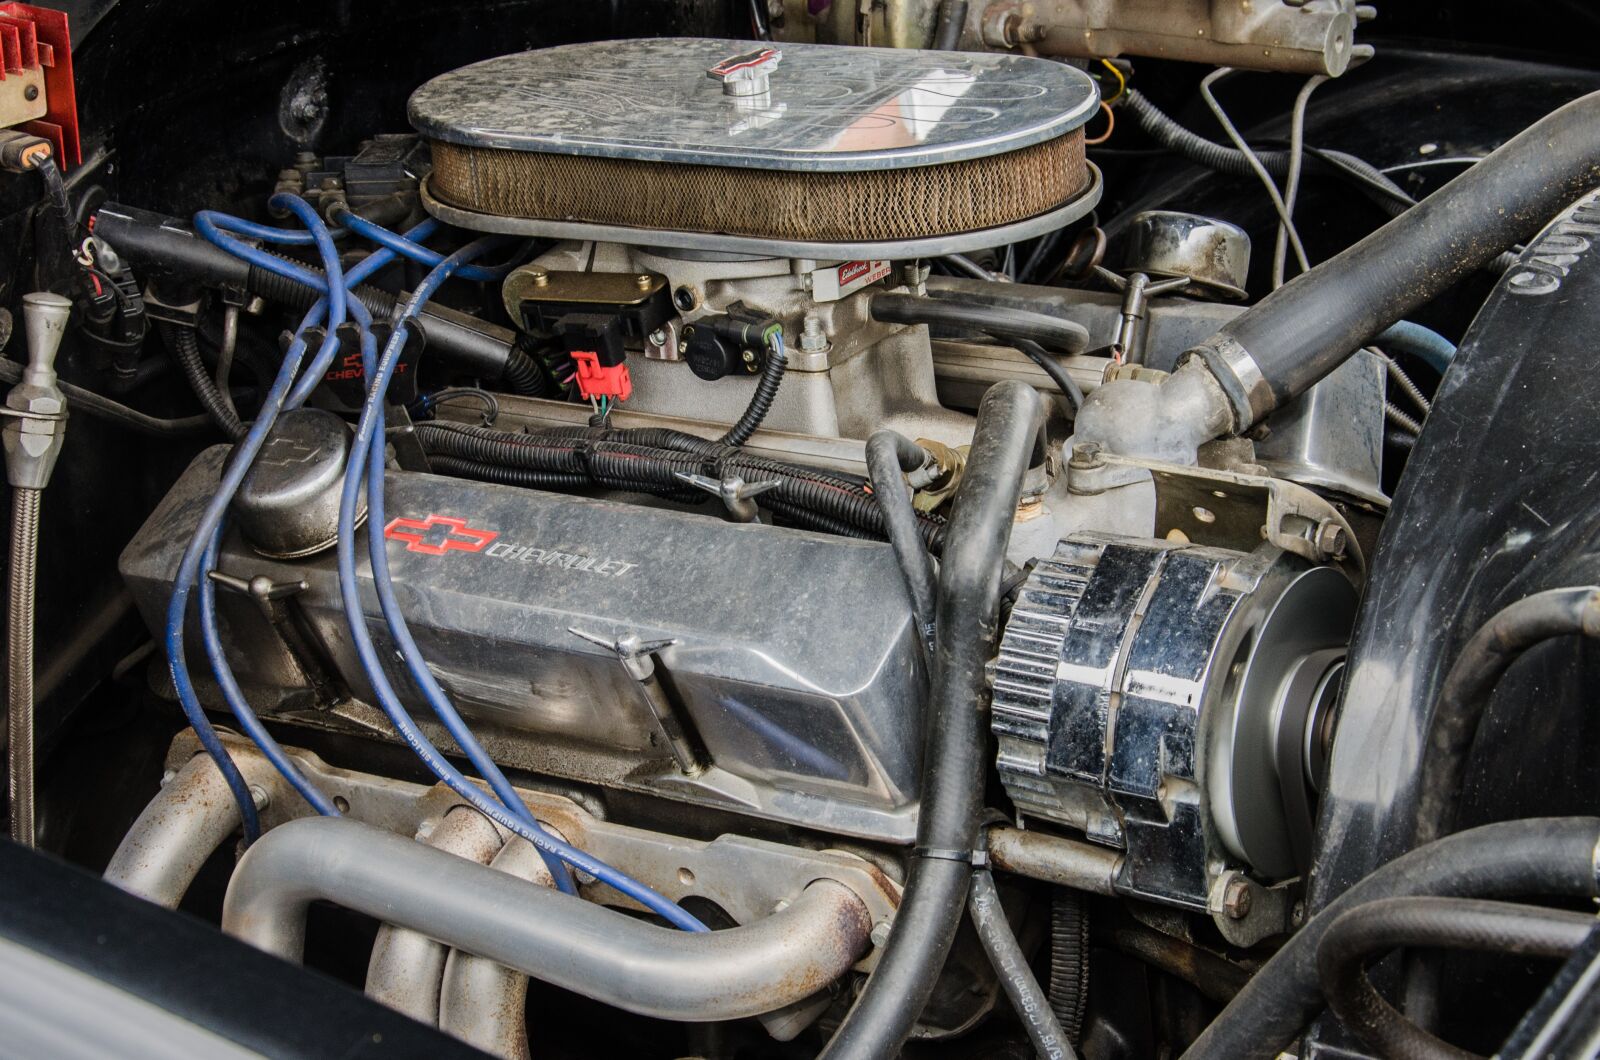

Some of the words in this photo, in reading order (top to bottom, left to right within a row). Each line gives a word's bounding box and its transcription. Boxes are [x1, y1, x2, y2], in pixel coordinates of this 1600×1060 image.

[865, 266, 890, 284] WEBER
[368, 373, 383, 402] RACING
[378, 331, 401, 371] EQUIPMENT
[485, 542, 639, 577] CHEVROLET
[399, 721, 432, 763] SILICONE
[431, 758, 451, 782] 8mm
[470, 793, 521, 834] EQUIPMENT
[521, 829, 558, 853] RACING
